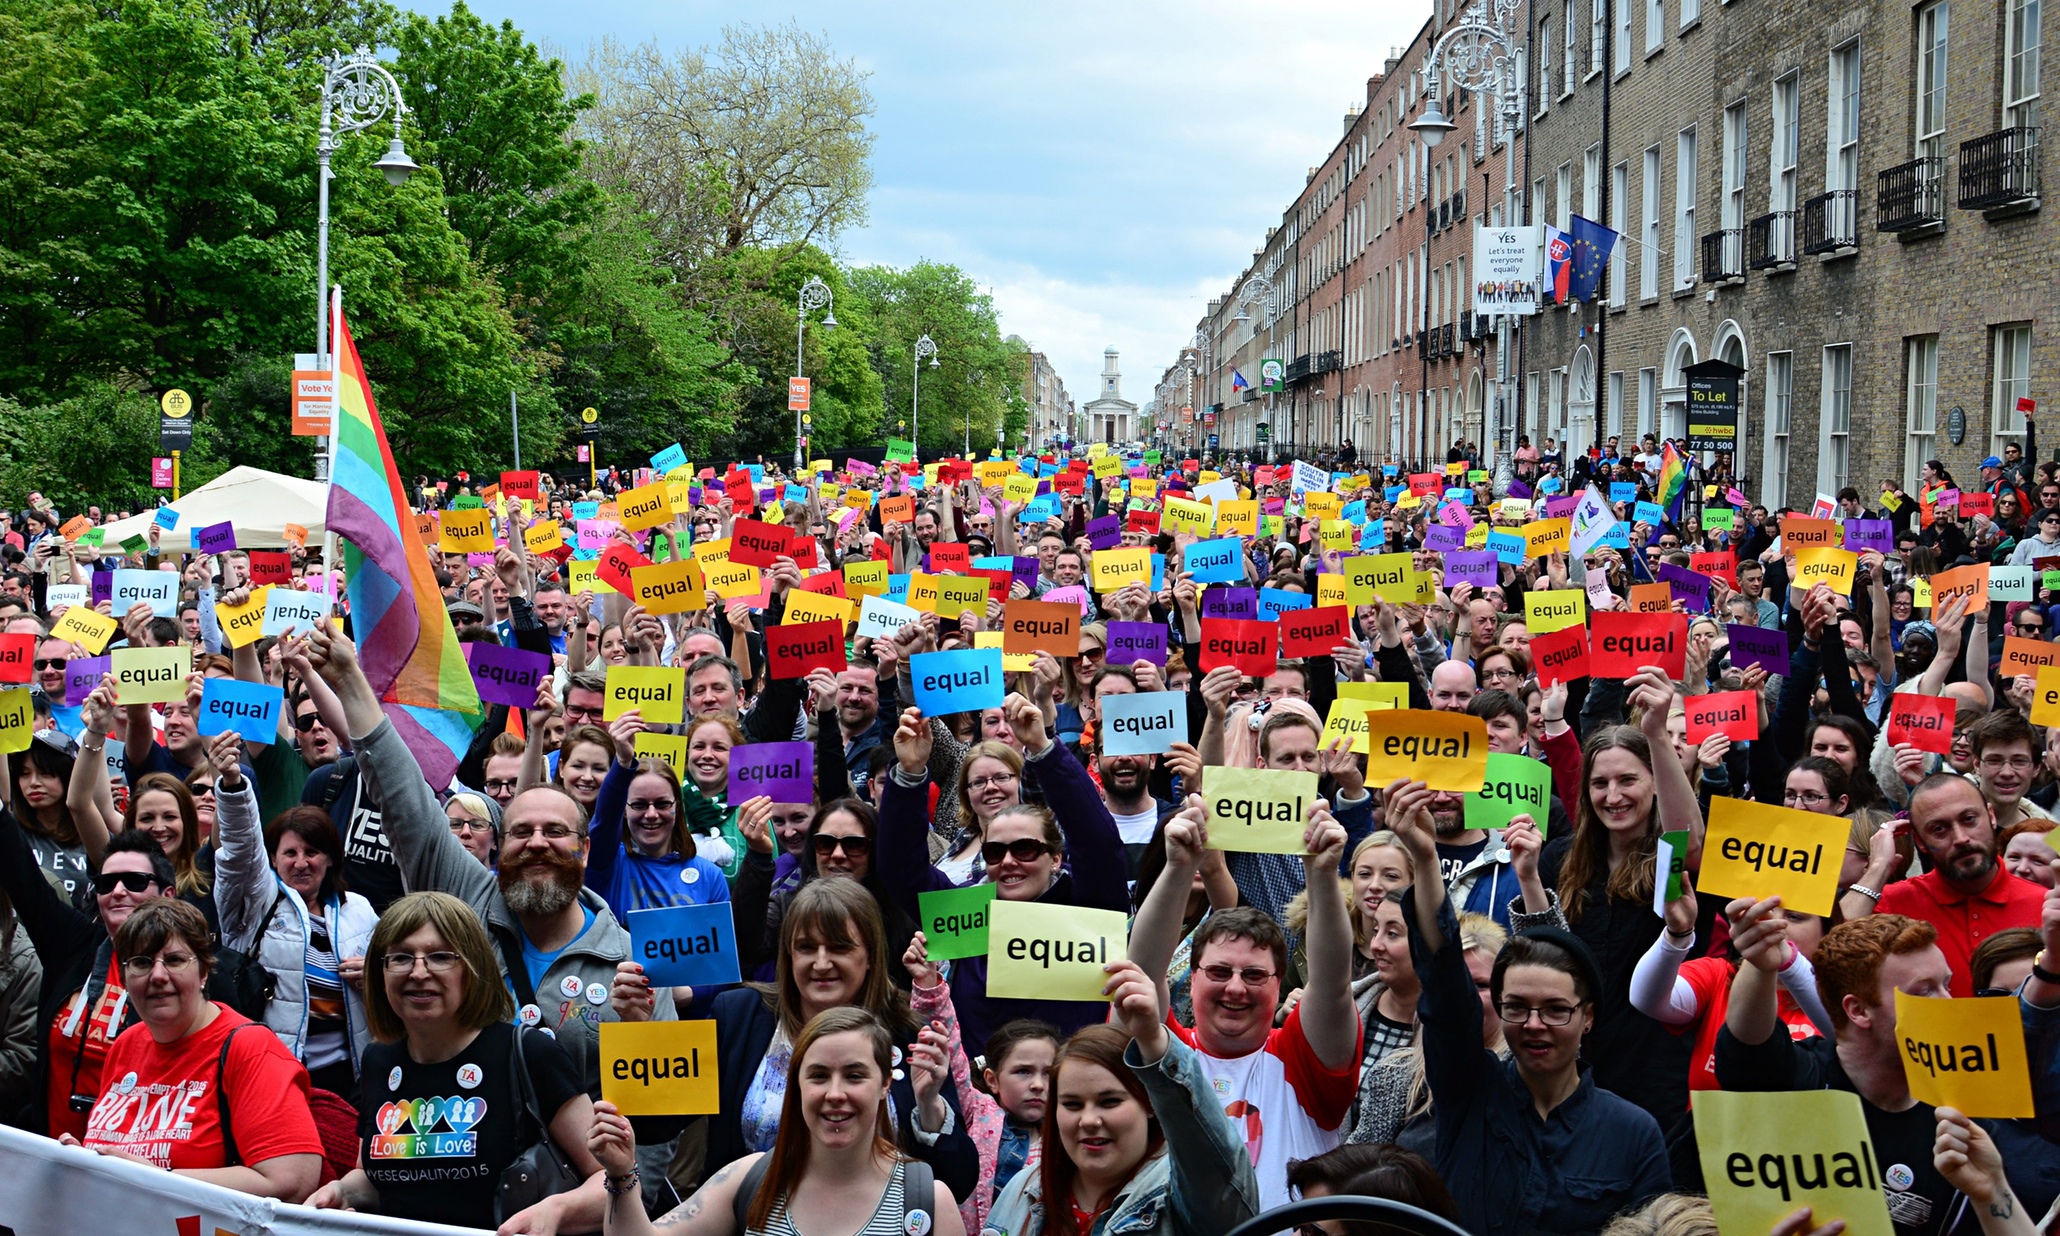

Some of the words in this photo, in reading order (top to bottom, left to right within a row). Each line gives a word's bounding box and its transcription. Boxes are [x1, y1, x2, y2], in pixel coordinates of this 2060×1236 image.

[1498, 232, 1516, 244] YES
[1490, 257, 1524, 265] everyone
[1494, 266, 1520, 274] equally
[791, 384, 806, 392] YES
[1692, 391, 1704, 402] To
[1708, 391, 1726, 402] Let
[891, 446, 909, 455] equal
[1717, 442, 1733, 450] 500
[657, 451, 680, 468] equal
[1097, 461, 1117, 472] equal
[667, 474, 686, 482] equal
[986, 469, 1010, 479] equal
[1299, 469, 1324, 484] DUBLIN
[1300, 464, 1324, 478] SOUTH
[505, 480, 532, 490] equal
[727, 476, 747, 489] equal
[1009, 484, 1033, 495] equal
[1057, 479, 1079, 487] equal
[1414, 480, 1438, 489] equal
[484, 489, 498, 498] equal
[787, 487, 803, 497] equal
[849, 495, 868, 503] equal
[624, 495, 662, 518] equal
[735, 498, 750, 506] equal
[883, 503, 907, 514] equal
[1024, 504, 1049, 514] equal
[1308, 501, 1330, 511] equal
[1964, 501, 1988, 509] equal
[576, 505, 596, 516] equal
[1170, 508, 1206, 523] equal
[1221, 511, 1250, 524] equal
[1638, 508, 1658, 517] equal
[1132, 518, 1155, 527] equal
[1706, 515, 1729, 524] equal
[64, 520, 86, 537] equal
[287, 526, 304, 538] equal
[446, 522, 484, 537] equal
[1361, 529, 1380, 540] equal
[1466, 530, 1486, 539] equal
[1851, 528, 1886, 540] equal
[80, 531, 102, 542] equal
[201, 529, 229, 545] equal
[530, 530, 555, 546] equal
[1431, 532, 1458, 544] equal
[1531, 528, 1564, 545] equal
[1787, 530, 1827, 544] equal
[126, 538, 144, 550] equal
[739, 535, 786, 553] equal
[1490, 541, 1519, 554] equal
[876, 548, 889, 560] equal
[935, 552, 964, 562] equal
[1191, 551, 1233, 570] equal
[253, 561, 285, 575] equal
[1102, 561, 1143, 575] equal
[1452, 562, 1489, 573] equal
[1697, 561, 1729, 572] equal
[1804, 563, 1845, 576] equal
[712, 569, 751, 586] equal
[850, 571, 882, 584] equal
[1354, 568, 1403, 588] equal
[1988, 577, 2024, 589] equal
[119, 584, 167, 600] equal
[642, 575, 692, 599] equal
[1589, 583, 1604, 596] equal
[1665, 577, 1700, 596] equal
[51, 590, 80, 601] equal
[944, 589, 982, 603] equal
[1209, 600, 1248, 614] equal
[1533, 602, 1576, 618] equal
[67, 617, 102, 639] equal
[1014, 618, 1069, 637] equal
[1289, 620, 1340, 641] equal
[778, 636, 834, 658] equal
[1114, 636, 1158, 650] equal
[1209, 637, 1265, 657] equal
[1603, 632, 1673, 656] equal
[1736, 639, 1781, 657] equal
[1543, 640, 1582, 668] equal
[2010, 650, 2053, 666] equal
[120, 664, 178, 684] equal
[478, 664, 537, 686] equal
[923, 666, 989, 692] equal
[615, 684, 671, 704] equal
[209, 691, 269, 720] equal
[0, 706, 25, 729] ual
[1693, 705, 1746, 725] equal
[1895, 710, 1943, 731] equal
[1113, 710, 1173, 735] equal
[1384, 731, 1468, 761] equal
[738, 760, 800, 783] equal
[1479, 781, 1543, 807] equal
[1216, 796, 1301, 825] equal
[1722, 837, 1822, 874] equal
[933, 905, 989, 936] equal
[645, 928, 719, 962] equal
[1007, 937, 1106, 968] equal
[590, 988, 604, 996] YES
[1906, 1033, 1999, 1077] equal
[613, 1049, 698, 1086] equal
[188, 1080, 208, 1092] 2015
[1214, 1082, 1230, 1091] YES
[88, 1092, 138, 1131] BIG
[128, 1087, 204, 1134] LOVE
[164, 1128, 192, 1140] HEART
[374, 1137, 406, 1156] Love
[416, 1136, 427, 1155] is
[435, 1136, 472, 1154] Love
[1727, 1141, 1876, 1201] equal
[1893, 1168, 1911, 1184] YES
[910, 1212, 922, 1232] YES
